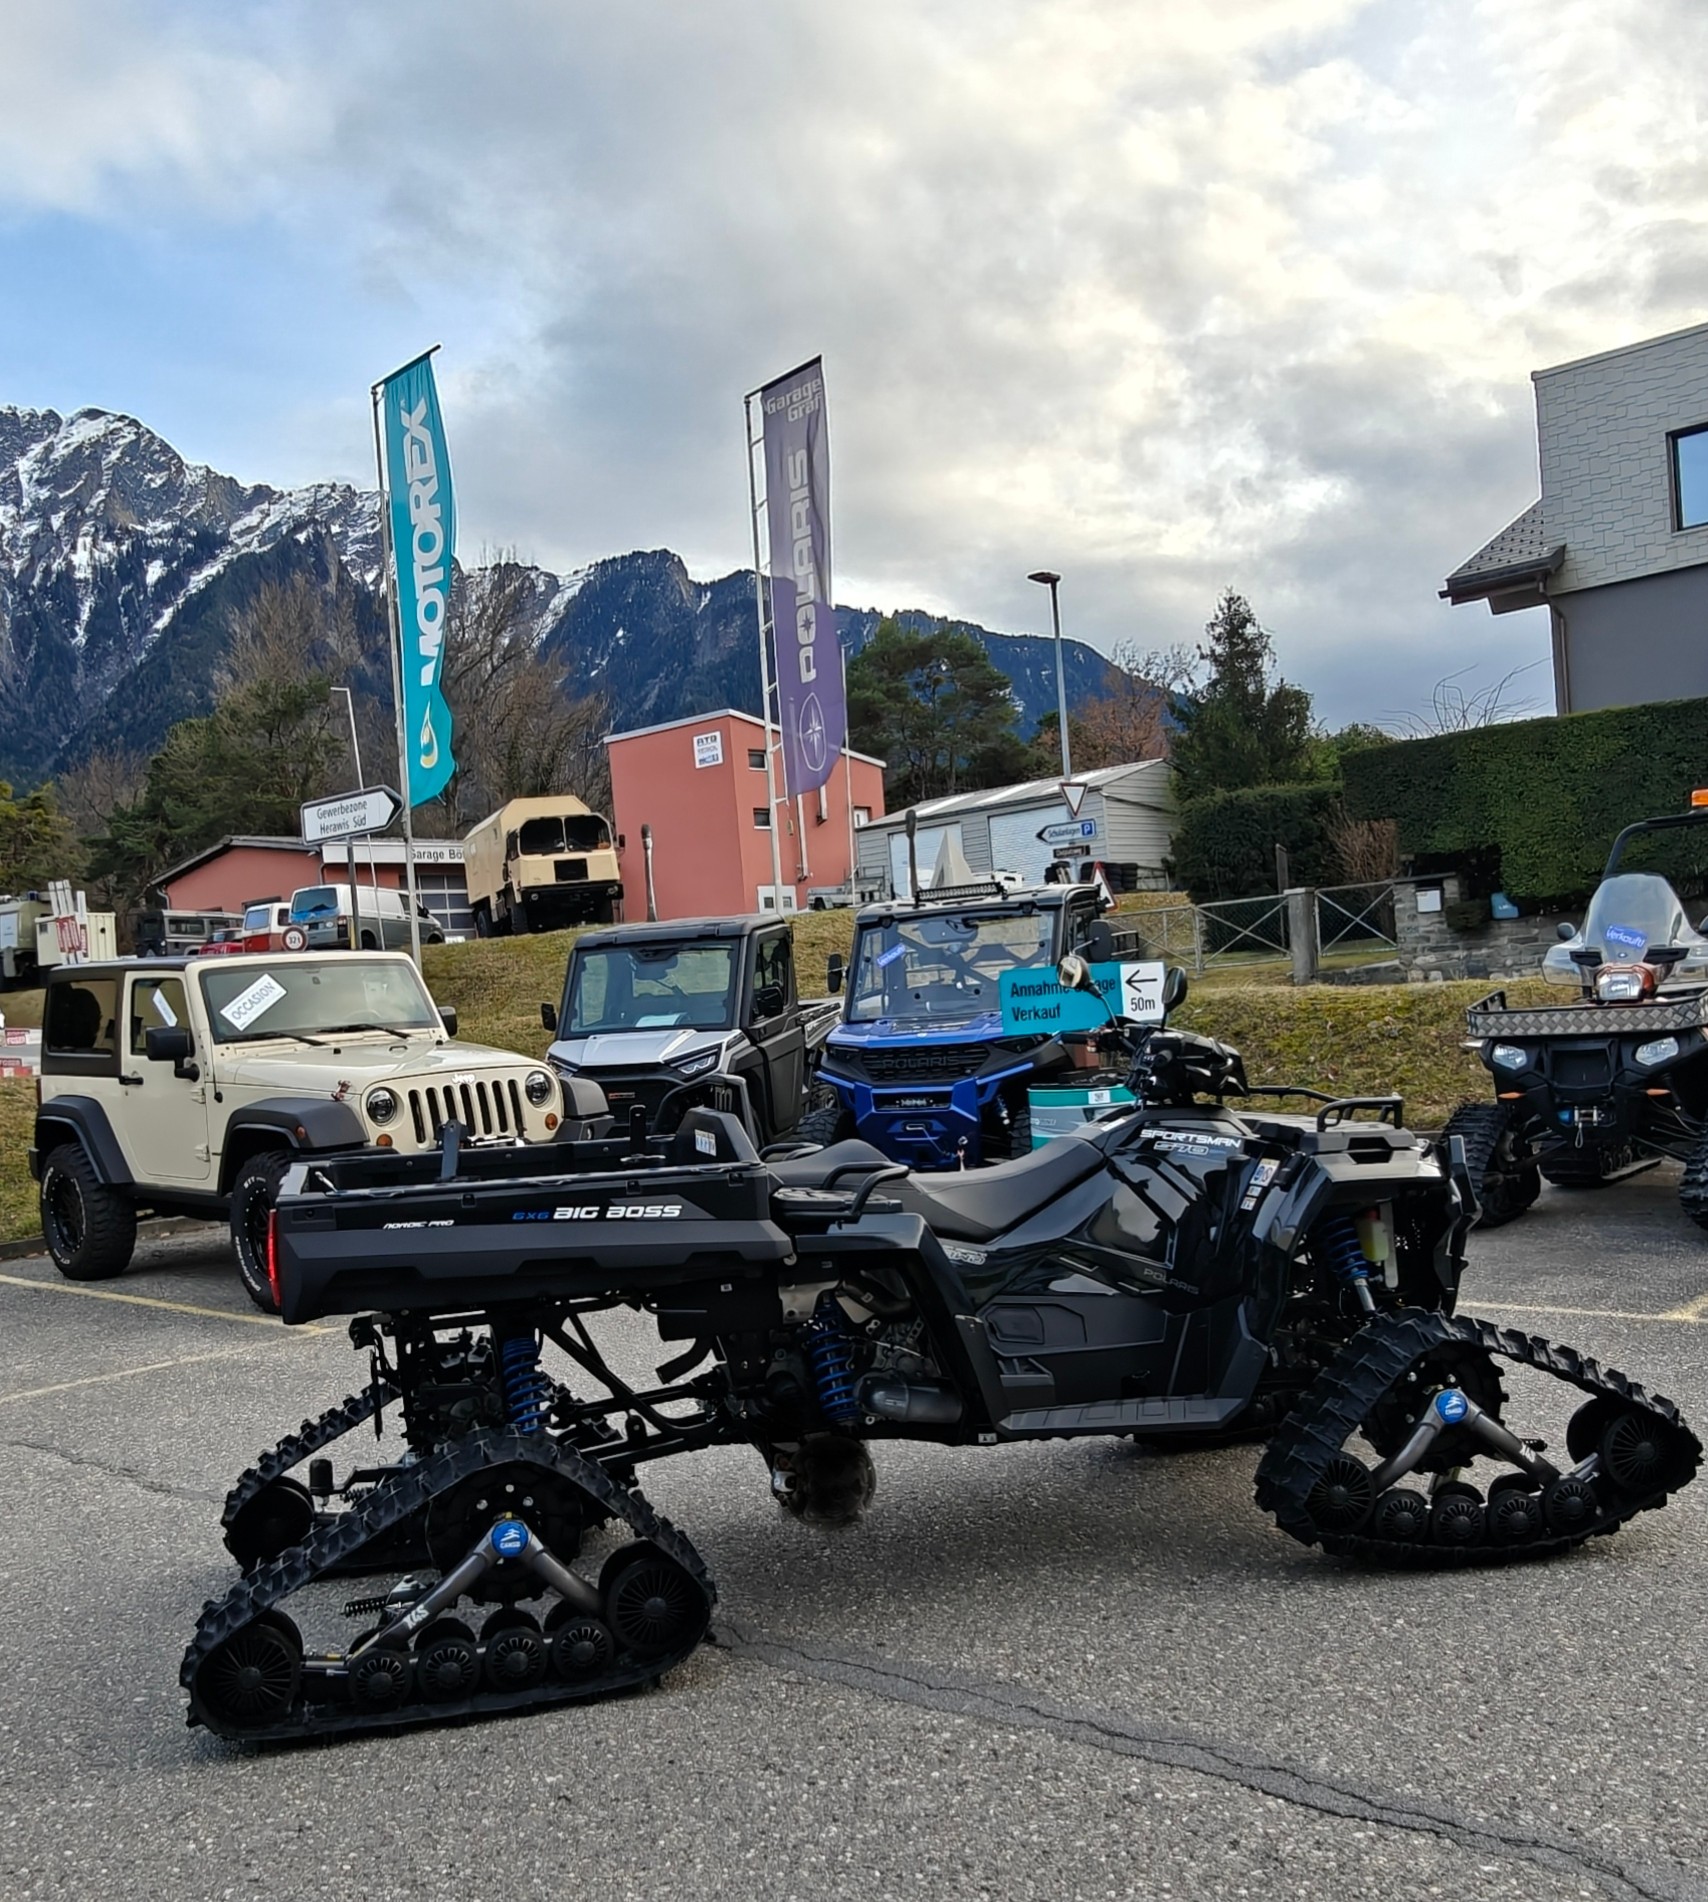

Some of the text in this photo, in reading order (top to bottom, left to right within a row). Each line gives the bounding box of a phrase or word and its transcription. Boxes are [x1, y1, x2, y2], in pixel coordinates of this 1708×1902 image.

[767, 379, 822, 415] Garage
[401, 397, 444, 687] MOTOREX
[788, 449, 817, 683] POLARIS
[317, 800, 368, 820] Gewerbezone
[320, 814, 367, 835] Herawis Süd
[231, 982, 276, 1021] OCCASION
[1130, 997, 1156, 1012] 50m
[1011, 1003, 1061, 1022] Verkauf
[452, 1073, 475, 1084] Jeep
[1140, 1129, 1242, 1149] SPORTSMAN
[553, 1206, 600, 1220] BIG
[606, 1205, 682, 1218] BOSS
[1144, 1268, 1199, 1295] POLARIS
